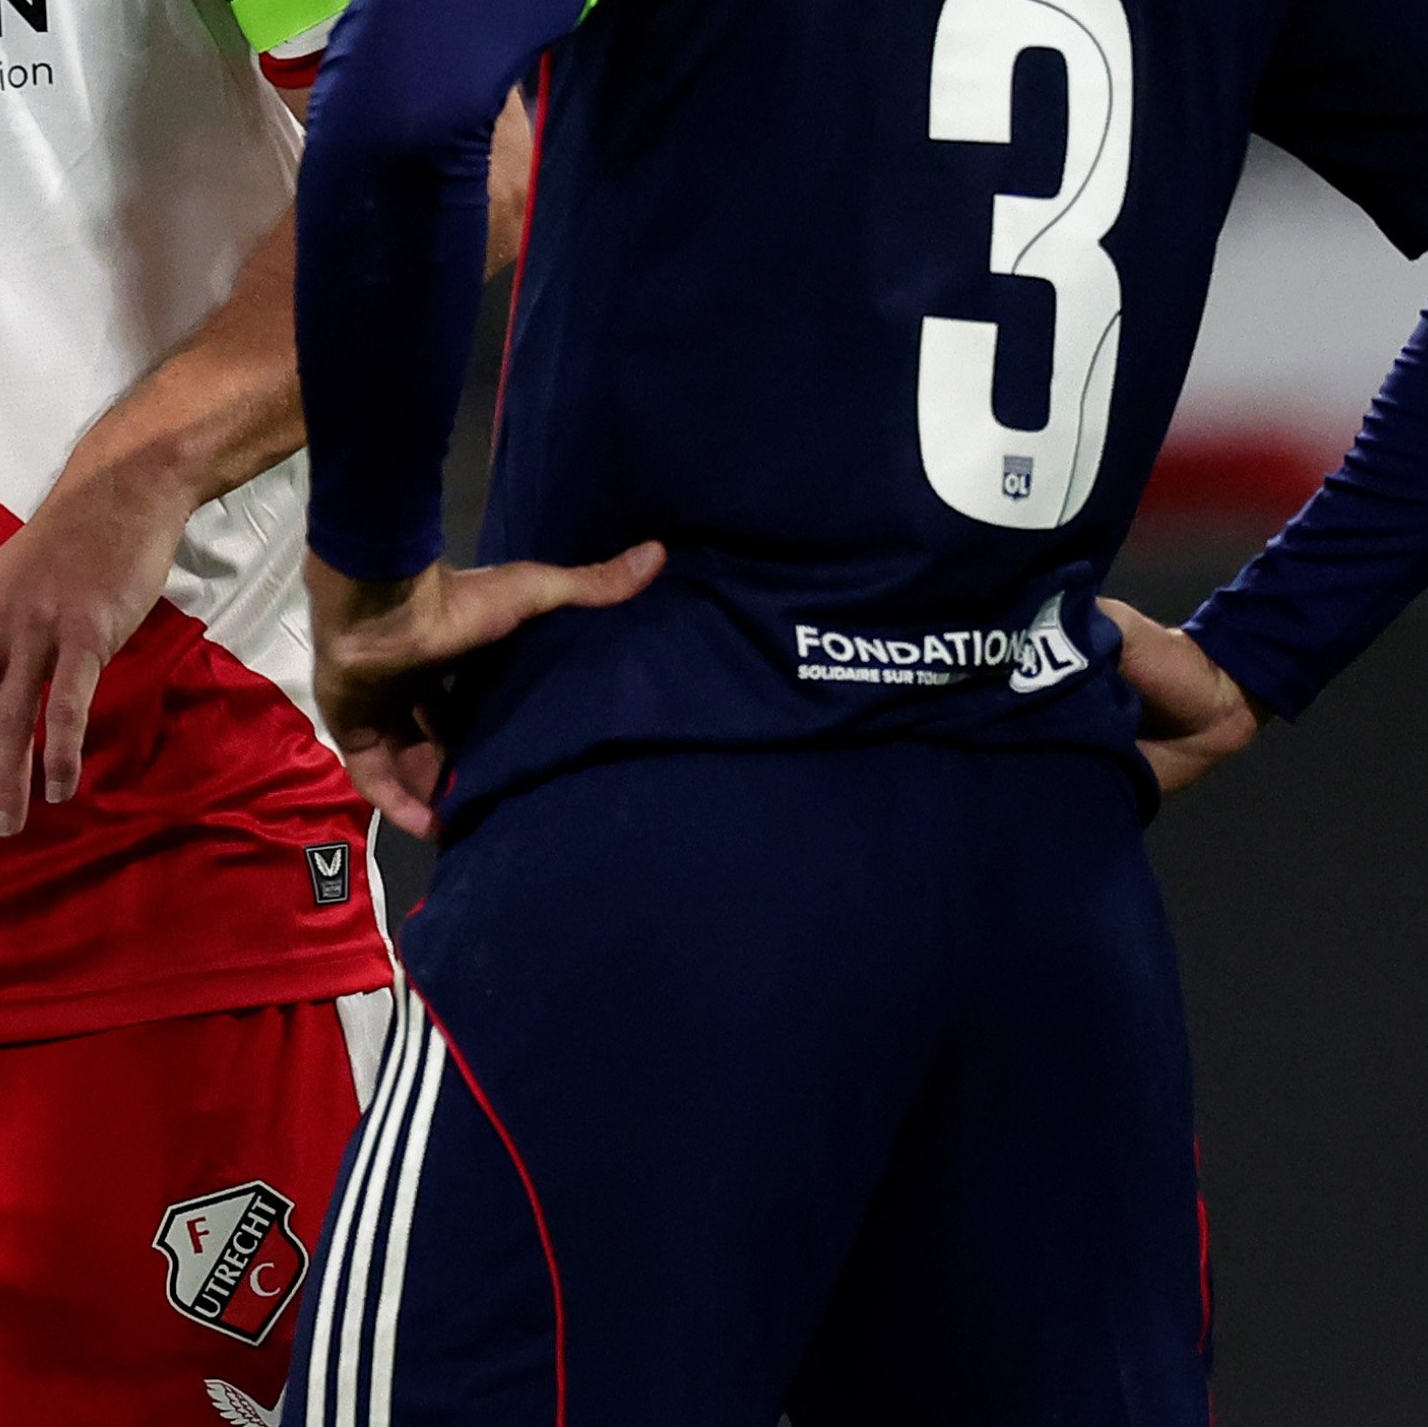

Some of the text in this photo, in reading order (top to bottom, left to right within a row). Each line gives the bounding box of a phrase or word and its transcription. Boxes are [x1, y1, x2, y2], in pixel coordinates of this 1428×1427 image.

[795, 624, 1028, 667] FONDATION
[882, 669, 914, 684] SUR
[186, 1216, 210, 1254] F
[194, 1195, 276, 1318] UTRECHT
[249, 1262, 281, 1297] C
